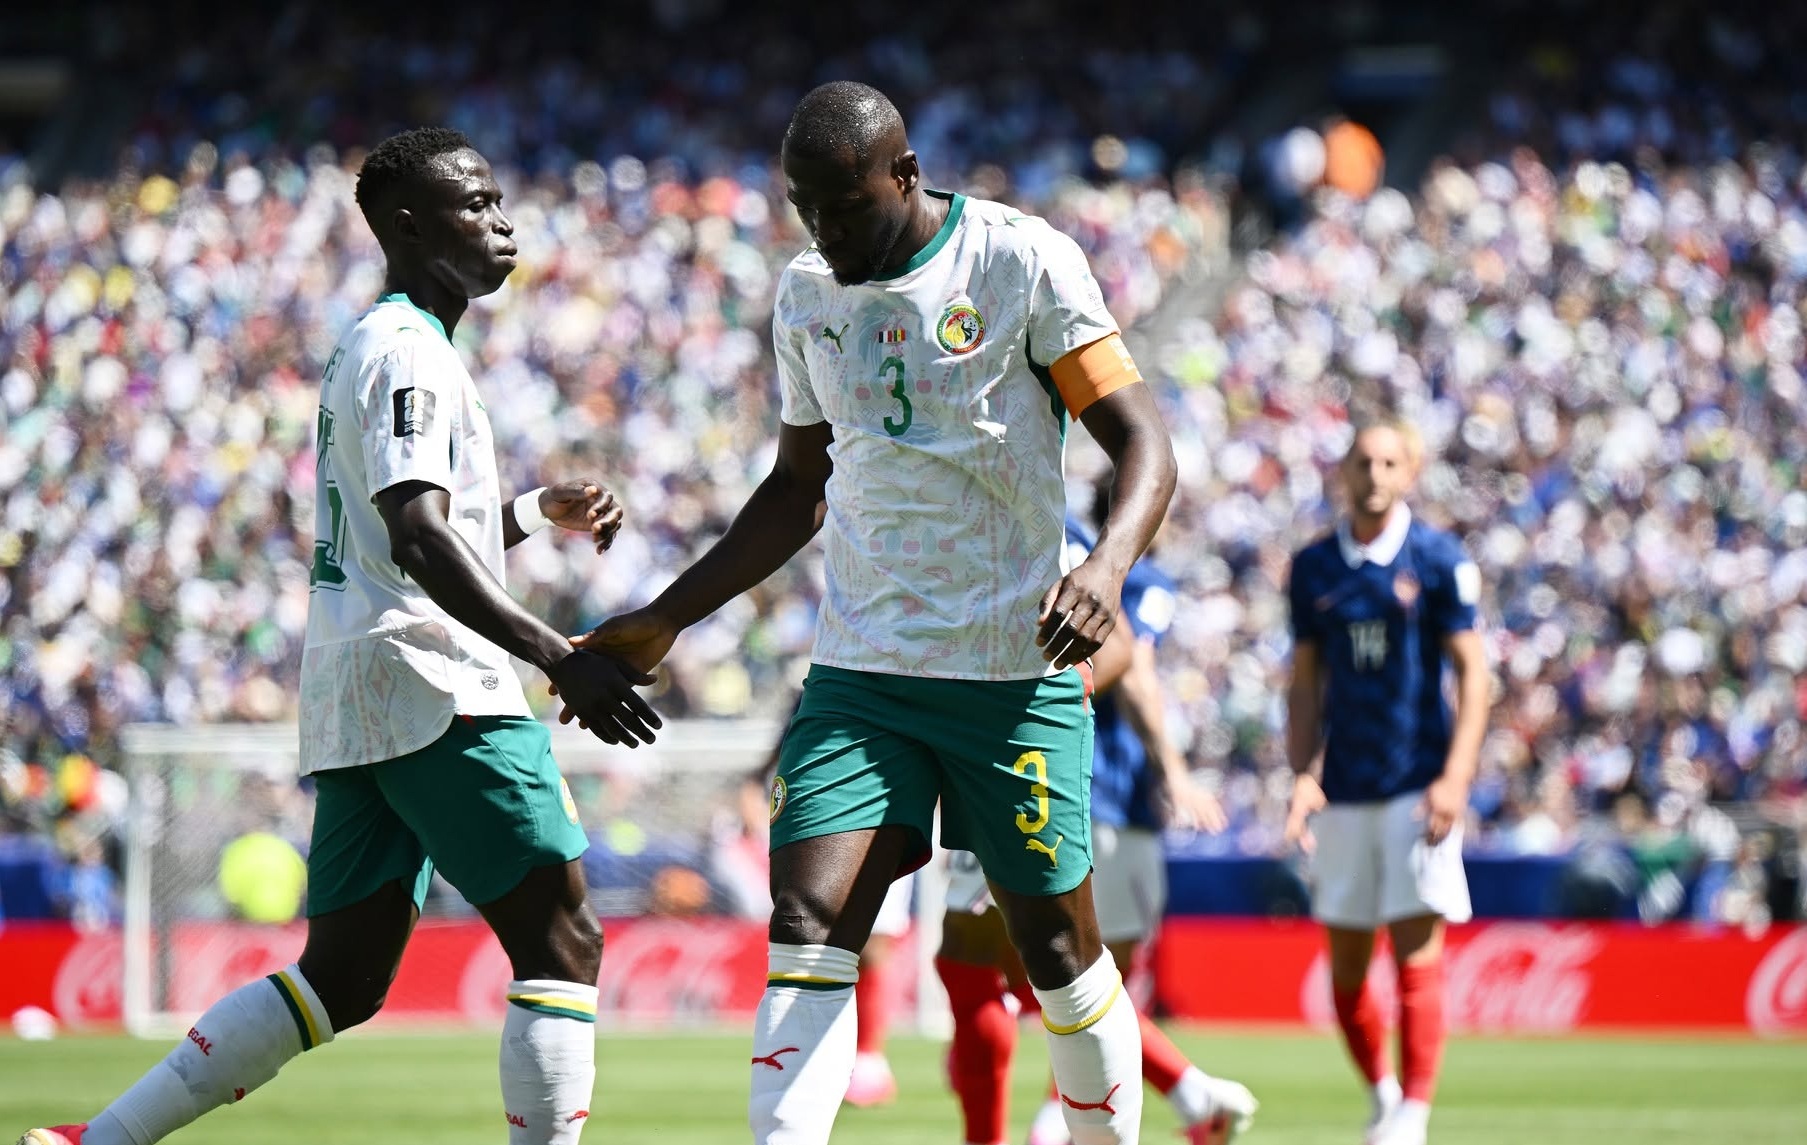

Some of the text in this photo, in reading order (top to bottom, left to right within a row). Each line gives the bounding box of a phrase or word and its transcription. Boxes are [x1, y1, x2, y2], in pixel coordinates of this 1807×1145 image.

[878, 356, 913, 437] 3
[1349, 621, 1388, 672] 14
[1013, 750, 1050, 835] 3
[187, 1027, 212, 1056] EGAL
